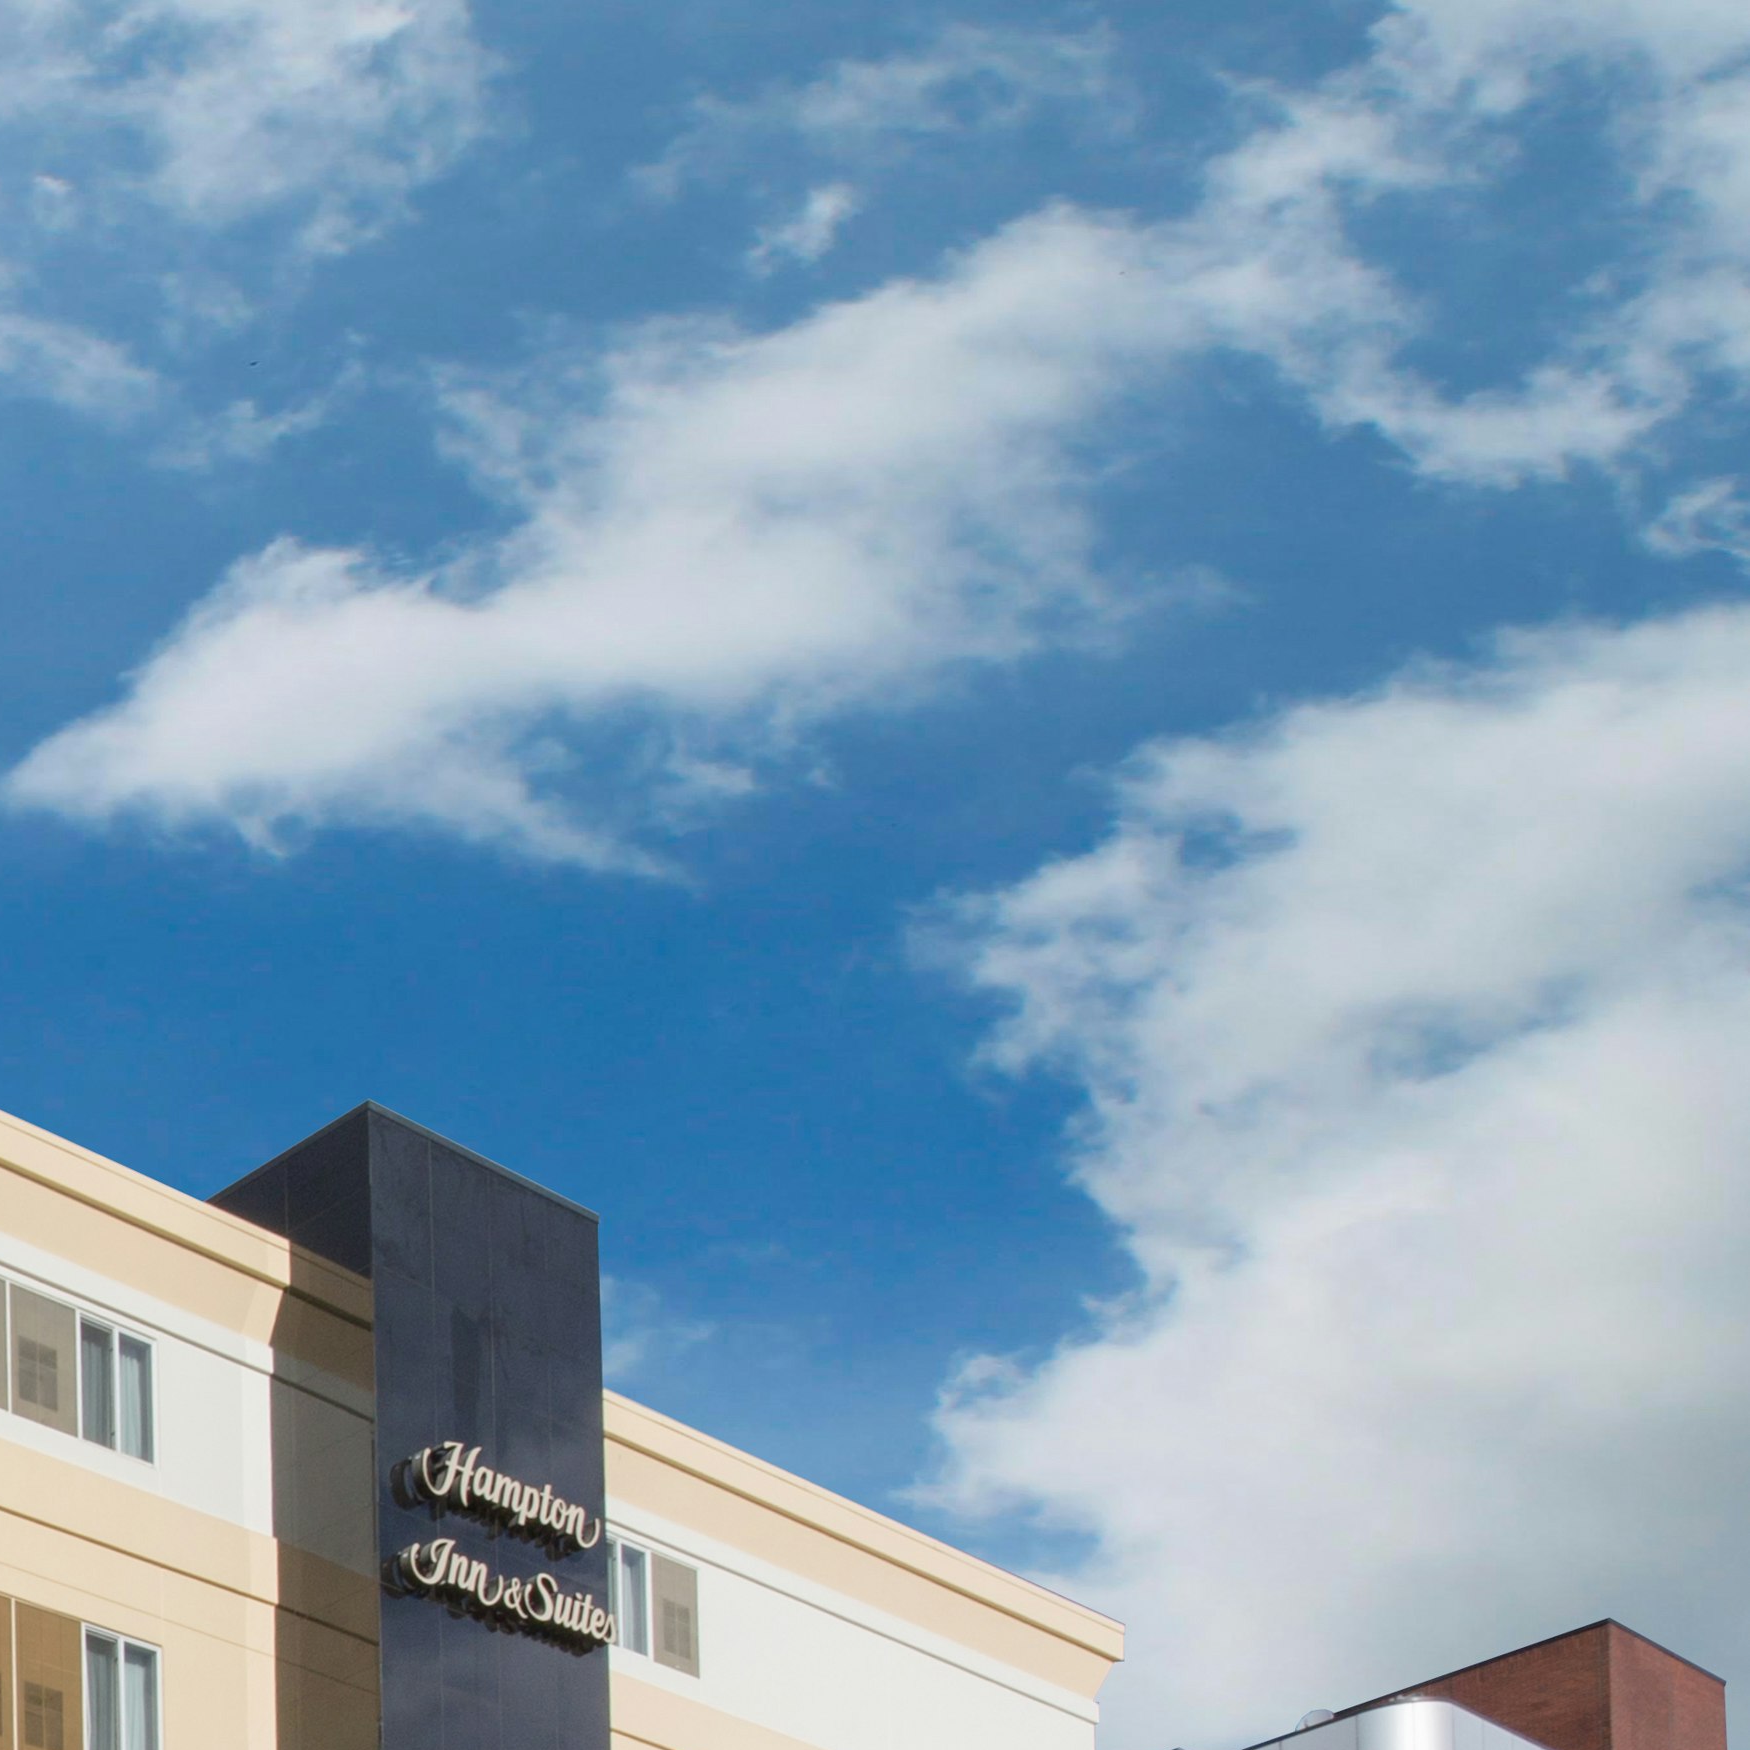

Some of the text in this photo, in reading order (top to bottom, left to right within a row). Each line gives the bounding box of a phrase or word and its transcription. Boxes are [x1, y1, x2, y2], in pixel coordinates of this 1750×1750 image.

[422, 1441, 600, 1548] Hampton
[410, 1538, 617, 1643] Inn & Suites
